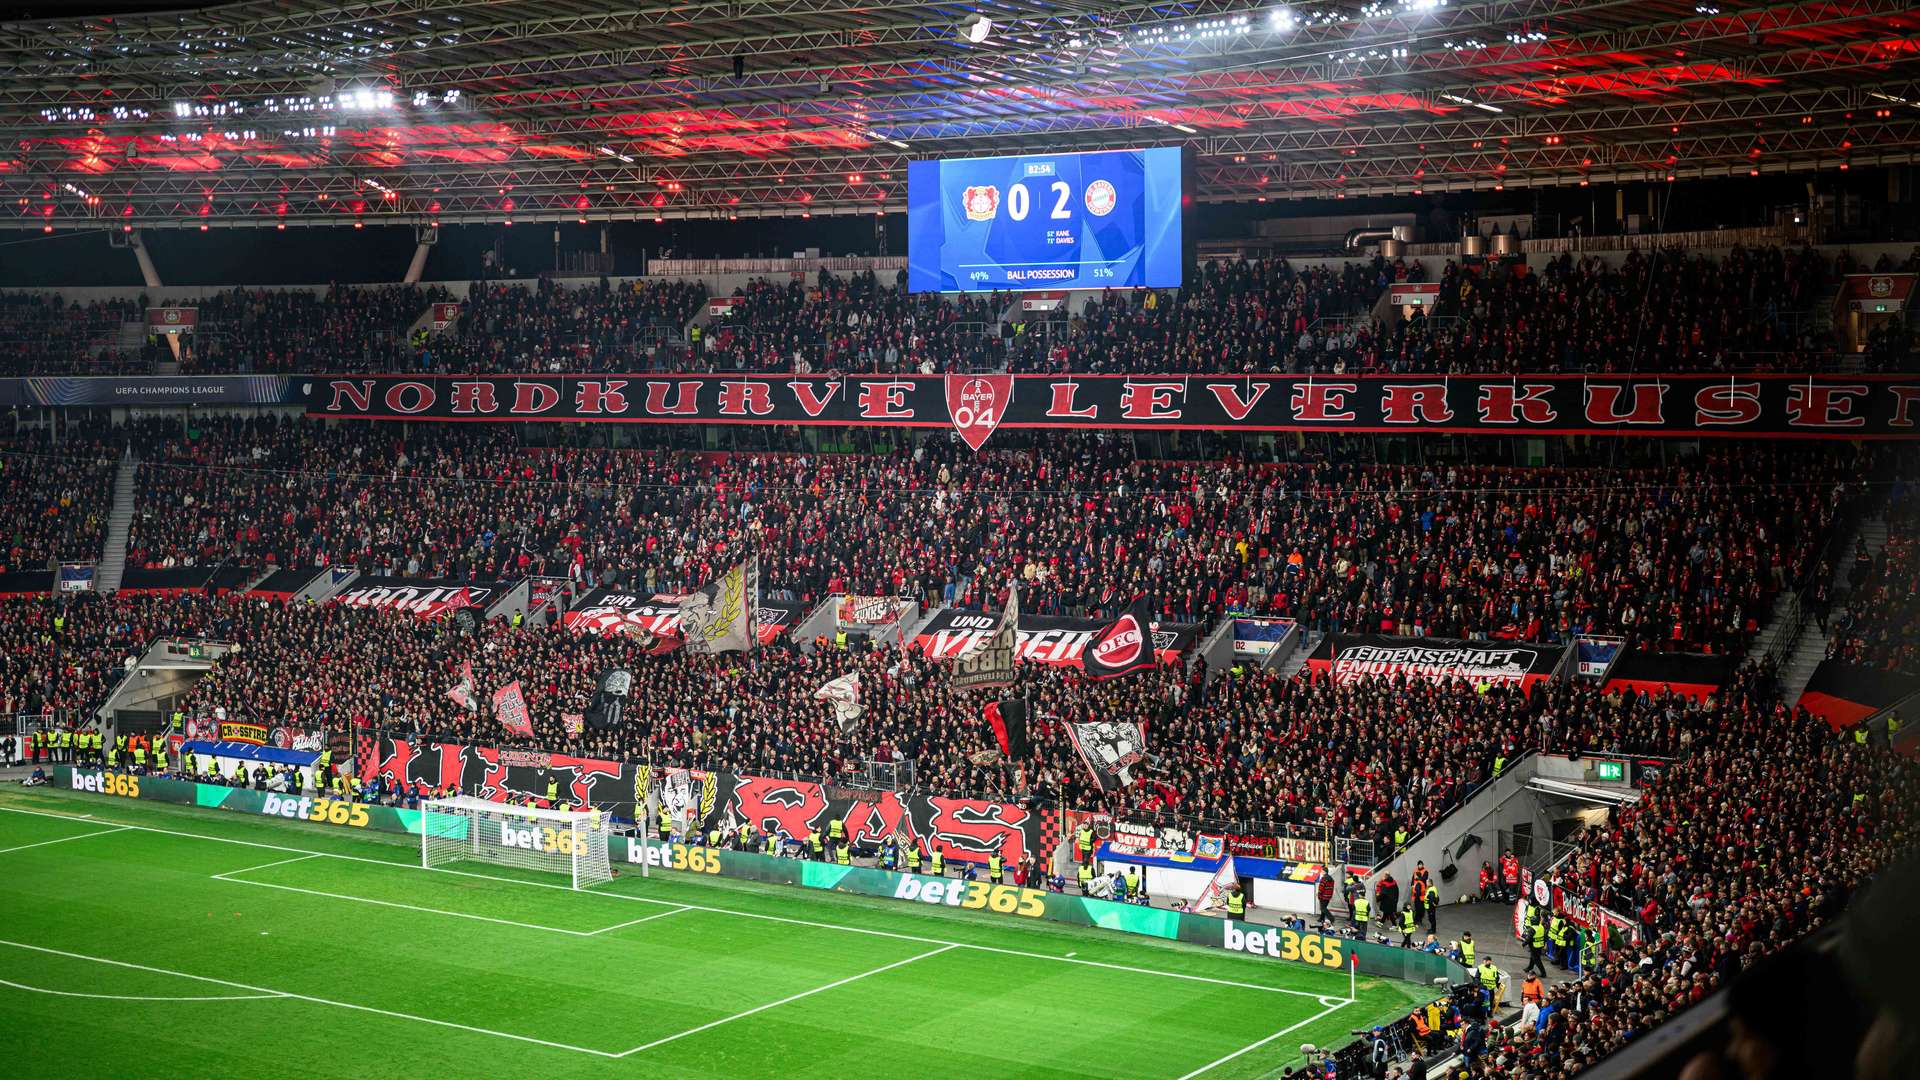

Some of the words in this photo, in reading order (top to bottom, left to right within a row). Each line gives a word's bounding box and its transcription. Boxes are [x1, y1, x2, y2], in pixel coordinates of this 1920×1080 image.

[1007, 183, 1030, 221] 0
[1050, 181, 1072, 220] 2
[969, 271, 989, 281] 49%
[1007, 269, 1026, 280] BALL
[1027, 268, 1075, 279] POSSESSION
[1093, 268, 1114, 278] 51%
[115, 387, 139, 395] UEFA
[139, 386, 190, 394] CHAMPIONS
[191, 386, 225, 394] LEAGUE
[326, 379, 916, 419] NORDKURVE
[962, 393, 993, 401] BAYER
[954, 406, 996, 429] 04
[949, 615, 995, 629] UND
[1235, 640, 1246, 650] D2
[1342, 647, 1520, 665] LEIDENSCHAFT
[1335, 659, 1476, 676] EMOTIONEN
[71, 767, 140, 798] bet365
[262, 792, 370, 827] bet365
[501, 820, 588, 857] bet365
[627, 837, 721, 874] bet365
[894, 872, 1047, 918] bet365
[1223, 919, 1343, 969] bet365
